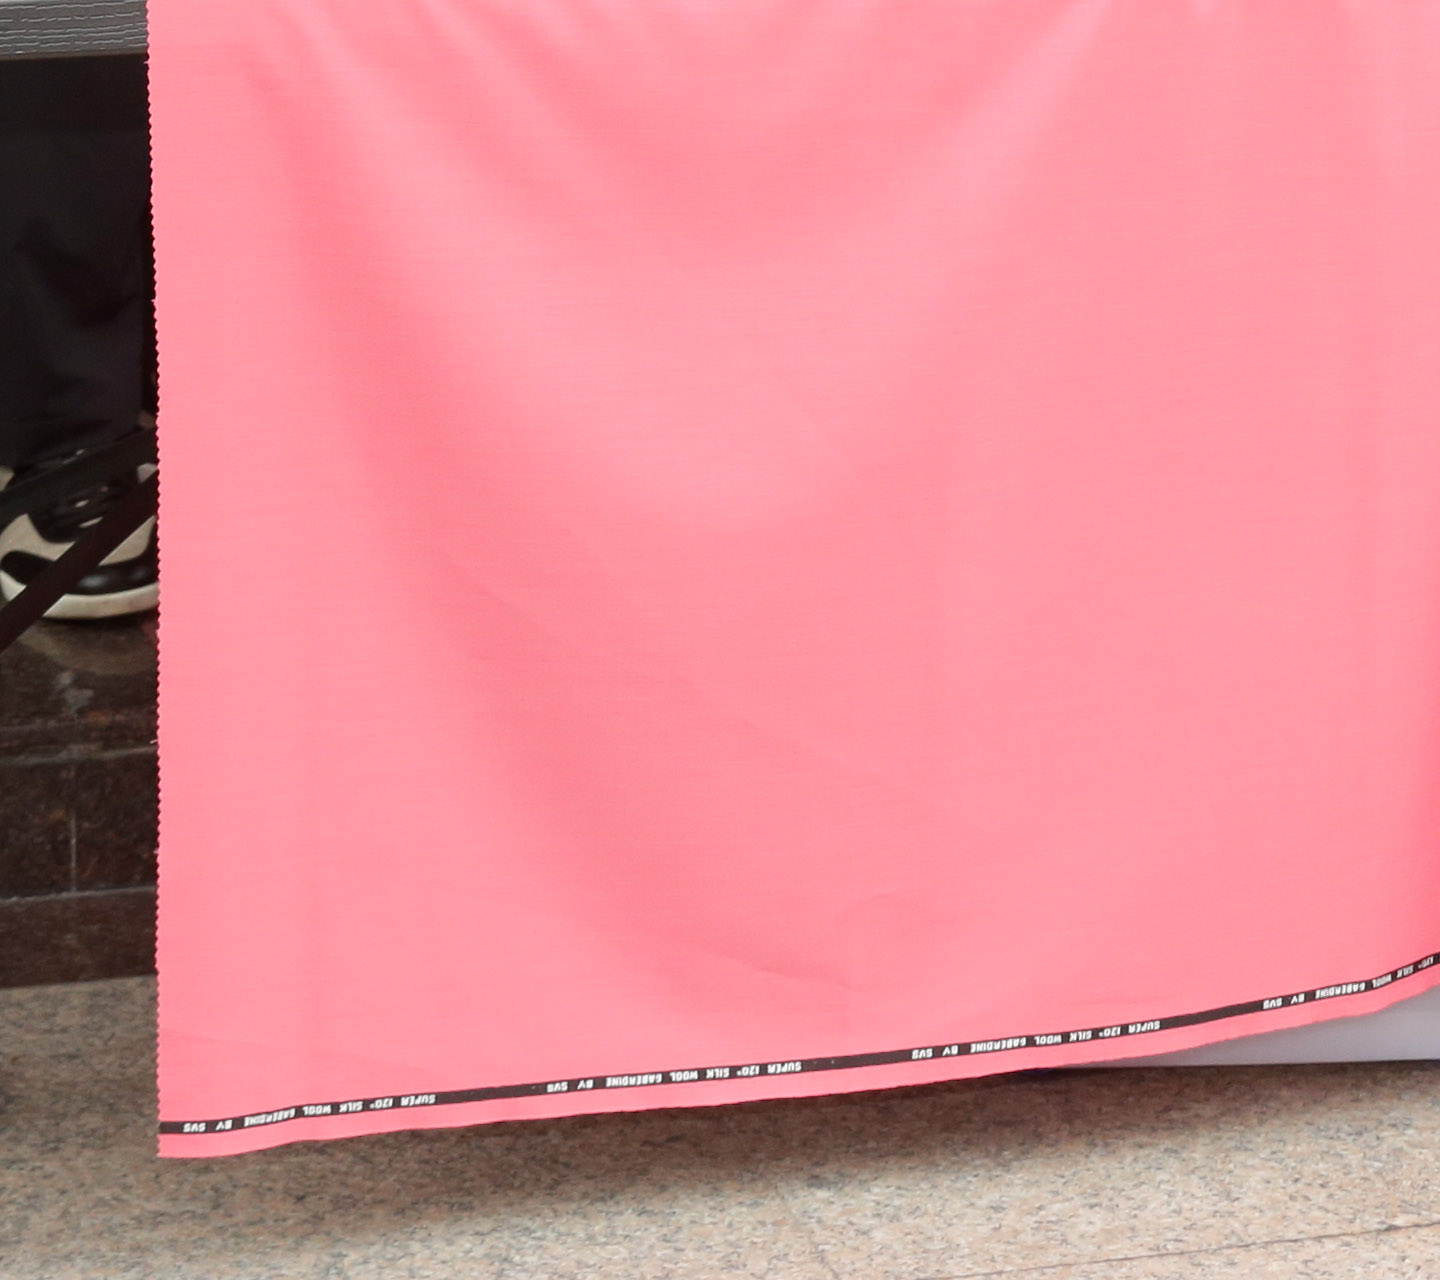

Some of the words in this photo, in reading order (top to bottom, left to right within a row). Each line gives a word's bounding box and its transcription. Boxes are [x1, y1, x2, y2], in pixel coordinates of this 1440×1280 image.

[1396, 965, 1413, 978] SILK
[1374, 974, 1392, 987] WOOL
[1290, 993, 1305, 1004] BY
[1128, 1020, 1161, 1034] SUPER
[1034, 1034, 1062, 1045] WOOL
[1069, 1030, 1092, 1042] SILK
[942, 1045, 959, 1057] BY
[706, 1067, 730, 1079] SILK
[767, 1061, 802, 1074] SUPER
[669, 1070, 699, 1082] WOOL
[577, 1079, 594, 1090] BY
[400, 1094, 436, 1106] SUPER
[302, 1104, 332, 1116] WOOL
[339, 1101, 363, 1113] SILK
[215, 1119, 233, 1131] BY
